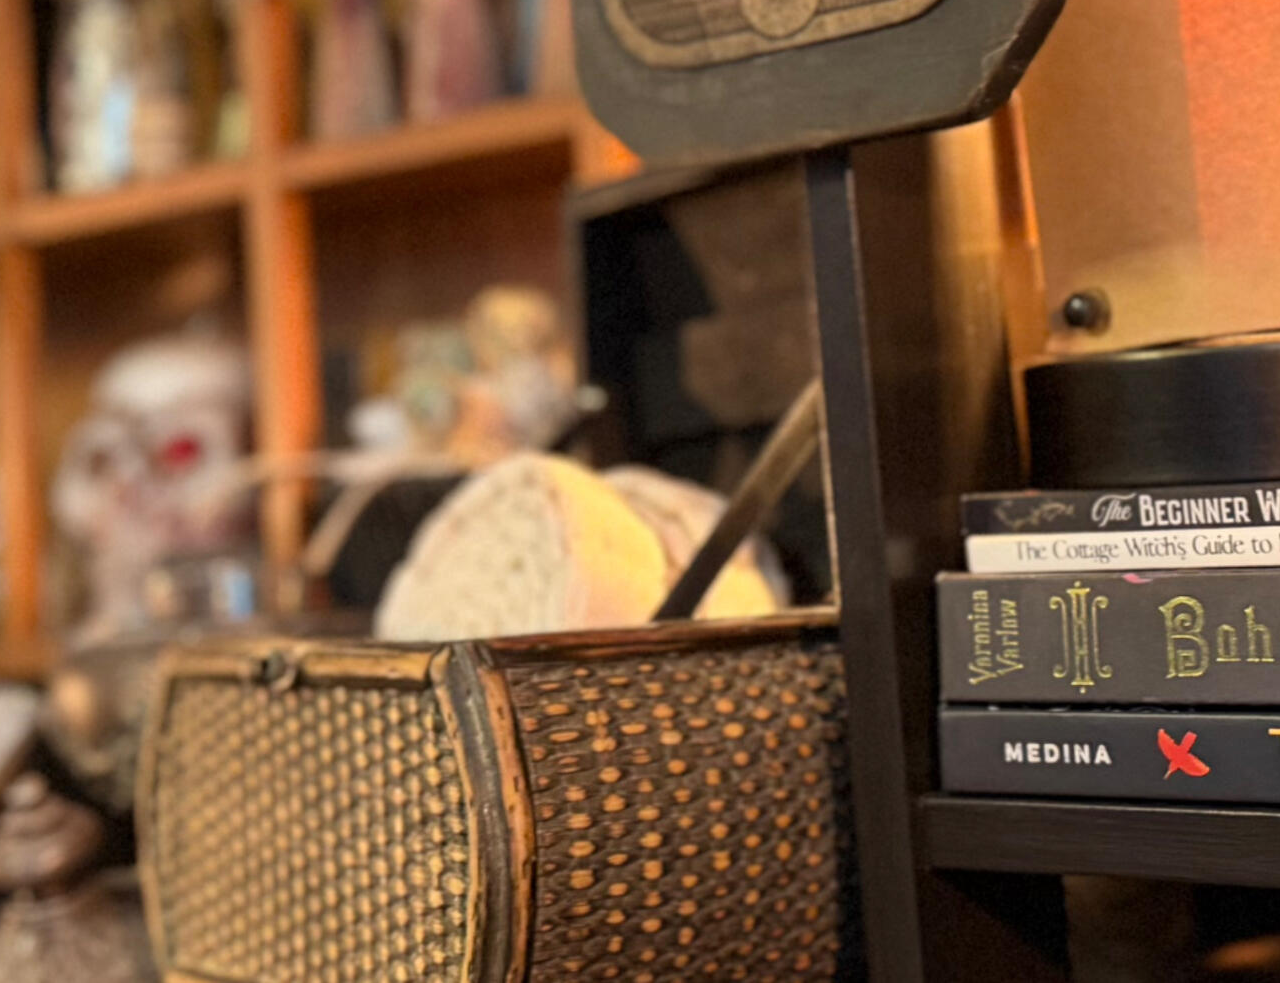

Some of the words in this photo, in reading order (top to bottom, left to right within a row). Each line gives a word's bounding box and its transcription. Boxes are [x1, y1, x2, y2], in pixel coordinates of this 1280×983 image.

[1091, 493, 1136, 527] The
[1138, 494, 1251, 527] BEGINNER
[1015, 540, 1047, 561] The
[1052, 539, 1120, 564] Cottage
[1123, 534, 1187, 560] Witch's
[1191, 533, 1245, 556] Guide
[1251, 536, 1272, 555] to
[967, 589, 997, 684] Veronica
[994, 598, 1024, 675] Varlow
[1004, 742, 1112, 765] MEDINA
